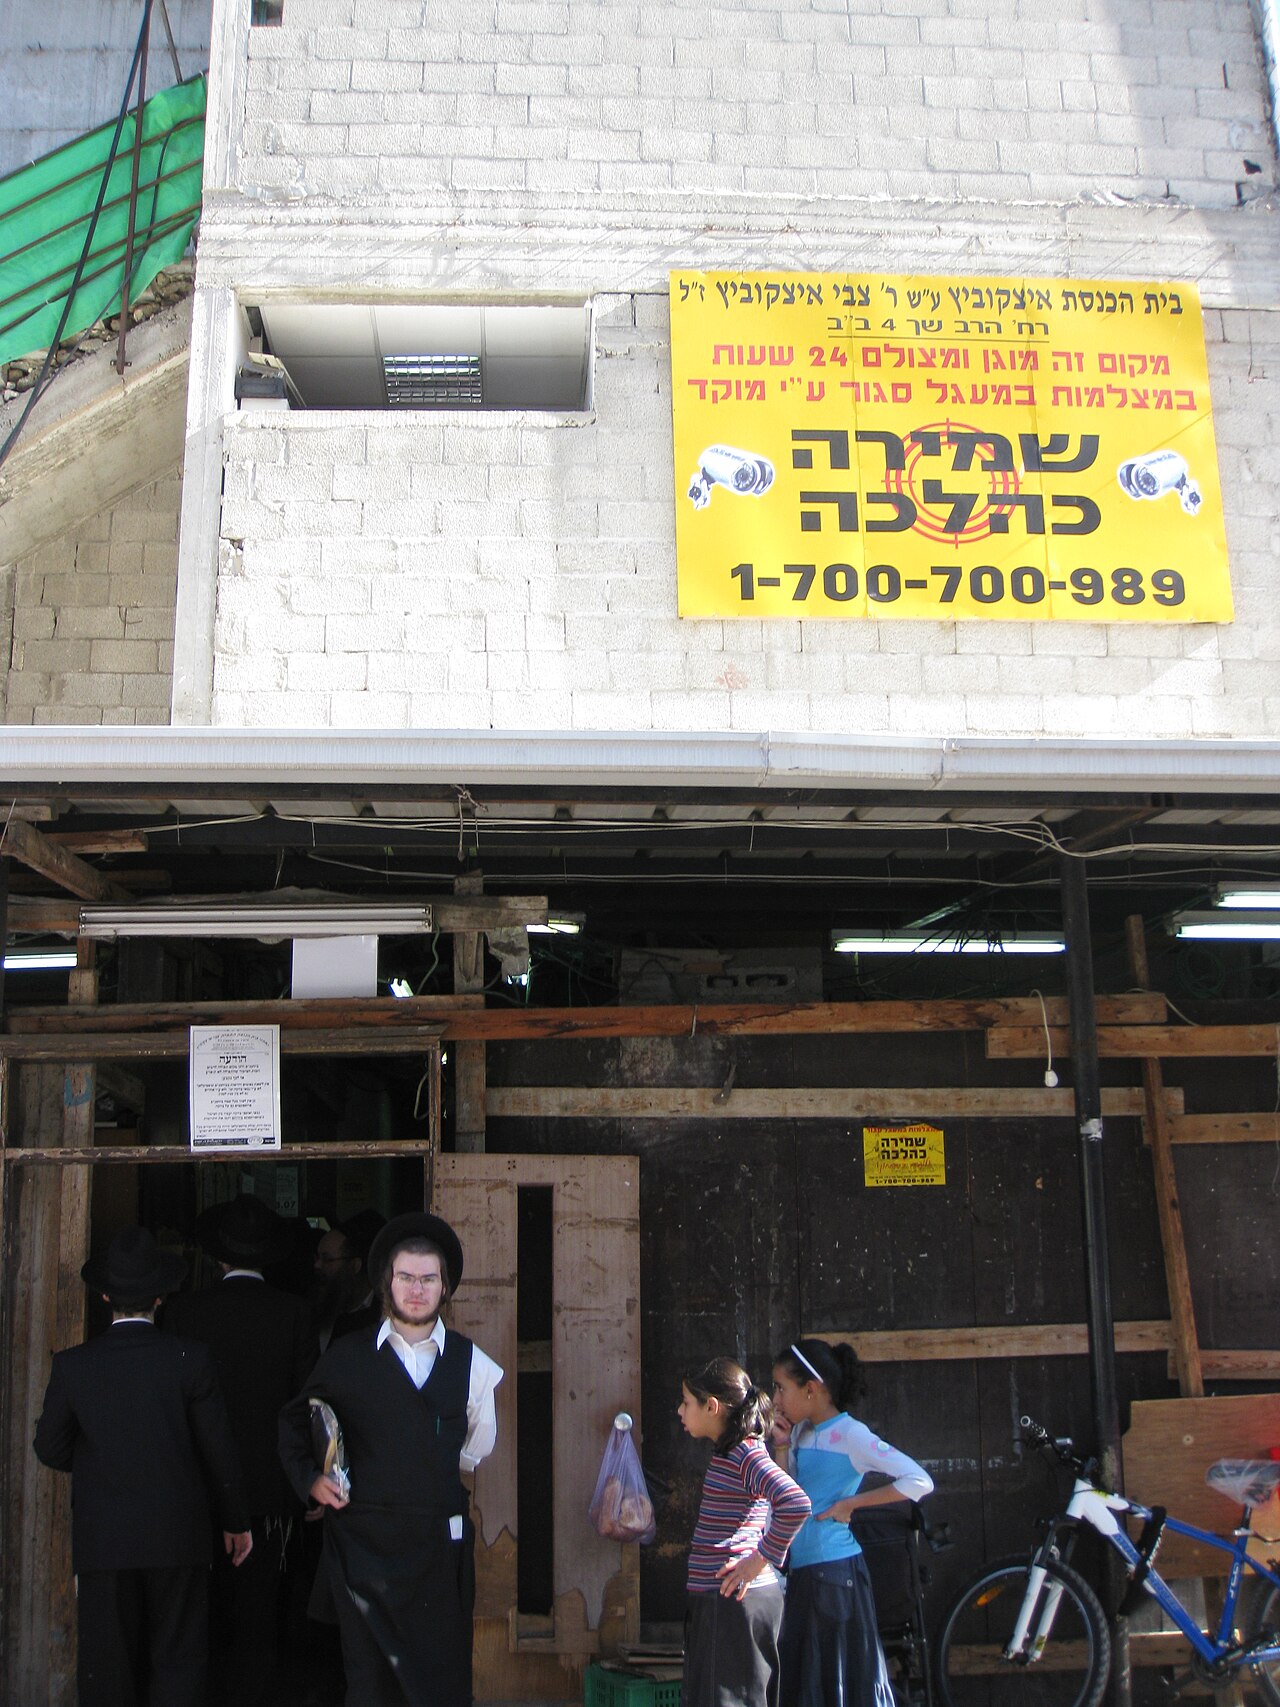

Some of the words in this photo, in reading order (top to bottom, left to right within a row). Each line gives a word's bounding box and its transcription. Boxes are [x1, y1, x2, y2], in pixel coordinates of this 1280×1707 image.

[716, 280, 824, 311] איצקוביץ
[832, 281, 871, 306] צבי
[948, 286, 1053, 316] איצקוביץ
[1061, 288, 1134, 314] הכנסת
[1143, 291, 1183, 315] בית
[881, 317, 896, 331] 4
[954, 320, 1002, 334] הרב
[711, 344, 794, 366] שעות
[808, 346, 848, 367] 24
[861, 343, 970, 371] ומצולם
[983, 349, 1039, 374] מוגן
[1051, 350, 1084, 373] זה
[1097, 352, 1171, 378] מקום
[687, 378, 766, 404] מוקד
[839, 381, 912, 404] סגור
[926, 378, 1037, 406] במעגל
[1051, 383, 1198, 411] במצלמות
[790, 428, 1101, 474] שמירה
[798, 479, 1102, 536] כהלכה
[729, 562, 1186, 606] 1-700-700-989
[219, 1055, 247, 1065] הודעה
[881, 1137, 927, 1147] שמירה
[881, 1148, 927, 1160] כהלכה
